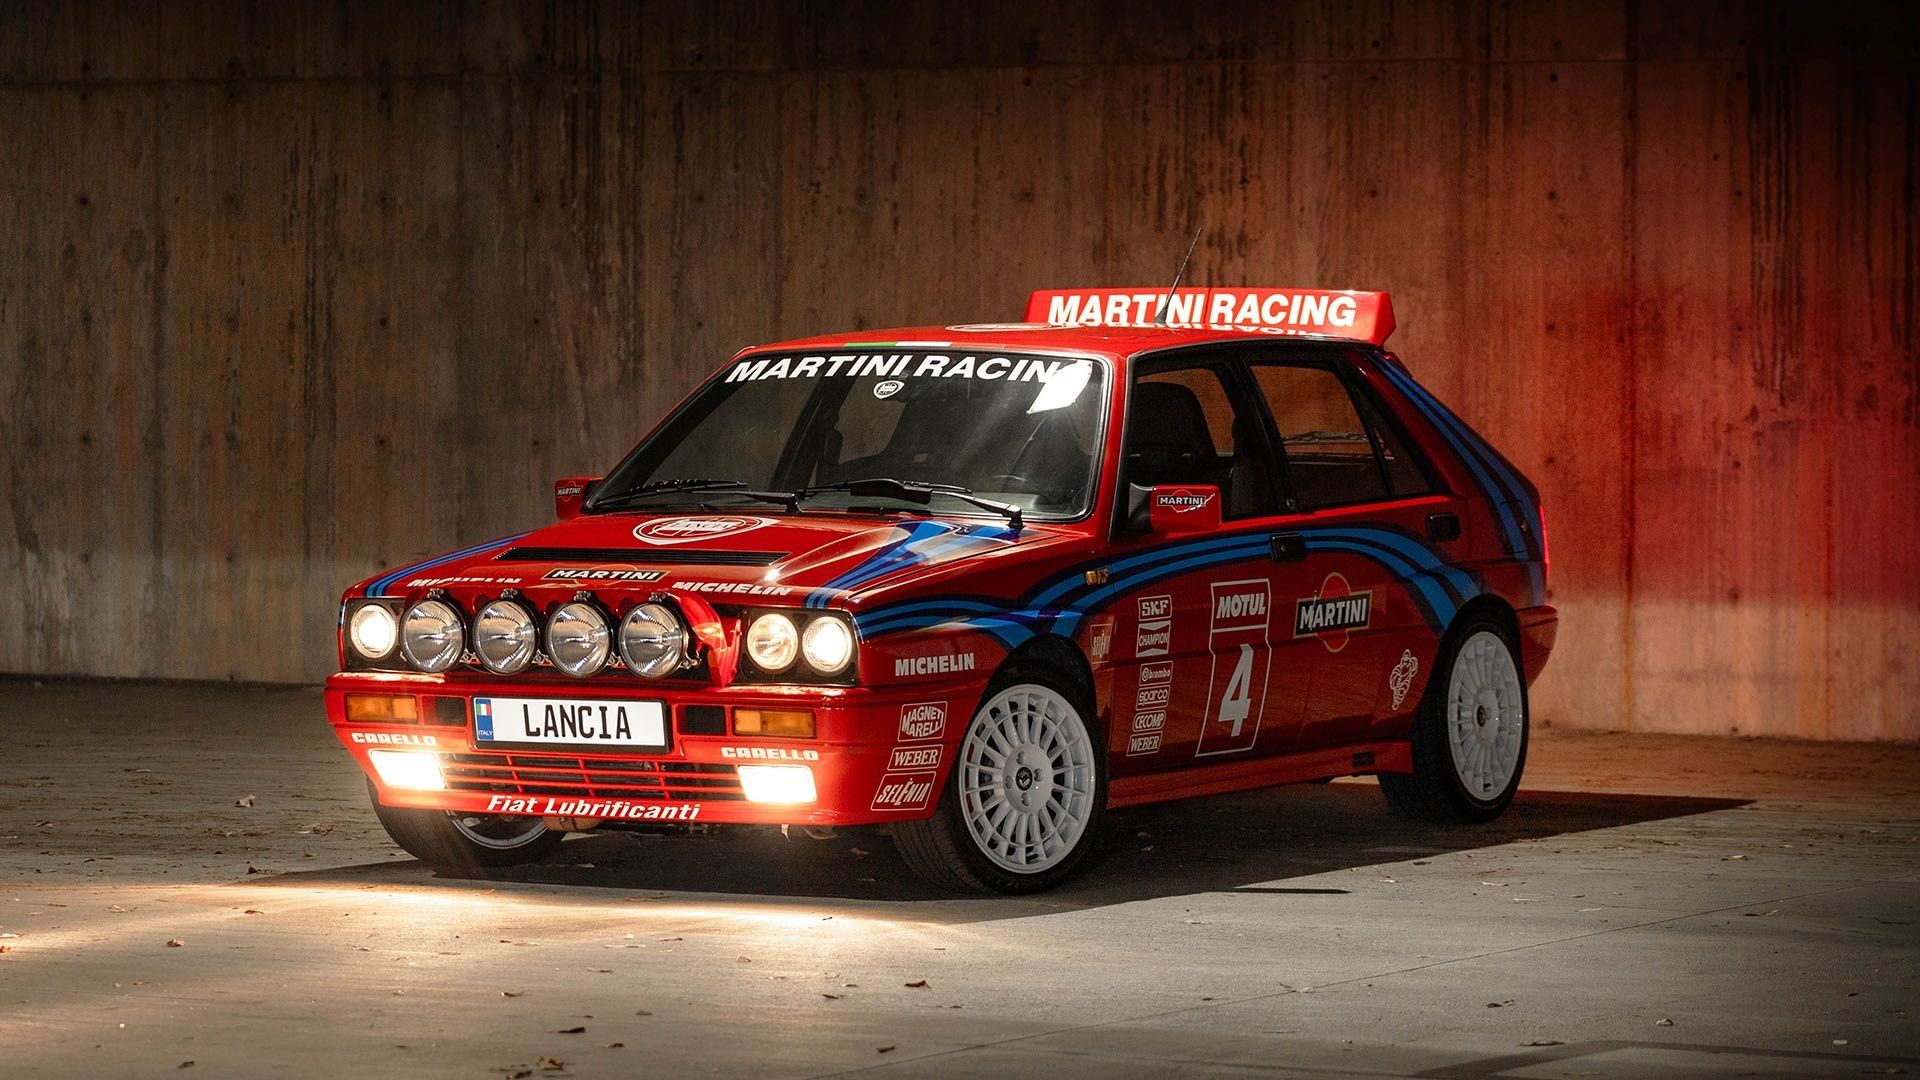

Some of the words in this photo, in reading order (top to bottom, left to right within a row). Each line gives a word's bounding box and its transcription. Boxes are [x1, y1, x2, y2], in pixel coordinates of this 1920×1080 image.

[1049, 294, 1201, 326] MARTINI
[1209, 295, 1356, 326] RACING
[725, 355, 911, 383] MARTINI
[913, 356, 1061, 383] RACIN
[1160, 497, 1204, 505] MARTINI
[551, 569, 661, 581] MARTINI
[671, 581, 792, 596] MICHELIN
[1141, 600, 1169, 617] SKF
[1216, 593, 1266, 619] MOTUL
[1299, 598, 1367, 631] MARTINI
[1139, 632, 1168, 647] CHAMPION
[895, 653, 975, 677] MICHELIN
[1138, 689, 1168, 706] sparco
[1218, 643, 1254, 737] 4
[523, 704, 632, 739] LANCIA
[1135, 713, 1165, 729] CECOMP
[351, 732, 437, 746] CARELLO
[1131, 736, 1160, 752] WEBER
[721, 747, 819, 761] CARELLO
[894, 749, 938, 767] WEBER
[487, 795, 537, 812] Fiat
[543, 797, 700, 820] Lubrificanti
